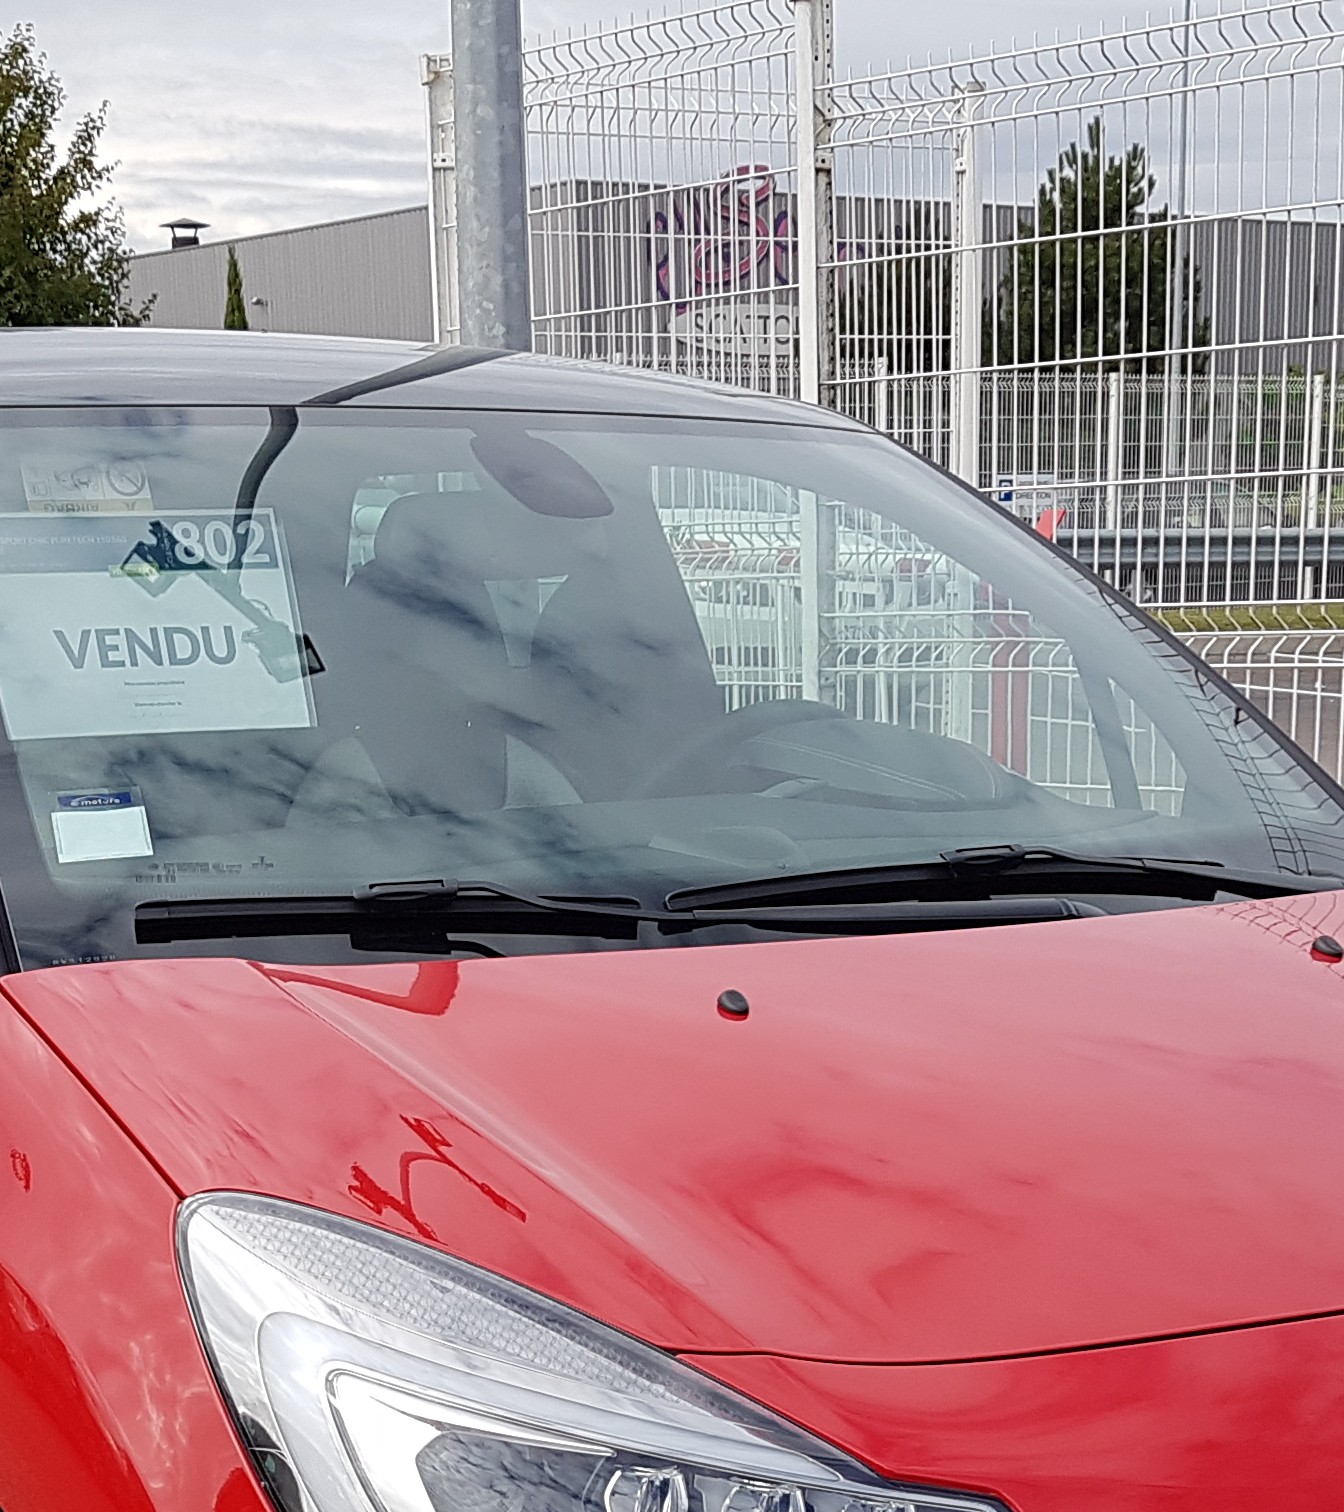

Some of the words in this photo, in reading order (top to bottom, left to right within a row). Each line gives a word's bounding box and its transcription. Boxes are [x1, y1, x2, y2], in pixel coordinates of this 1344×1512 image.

[694, 314, 801, 345] SCATTO
[1016, 491, 1052, 500] DIRECION
[173, 520, 271, 565] 802
[52, 625, 237, 670] VENDU
